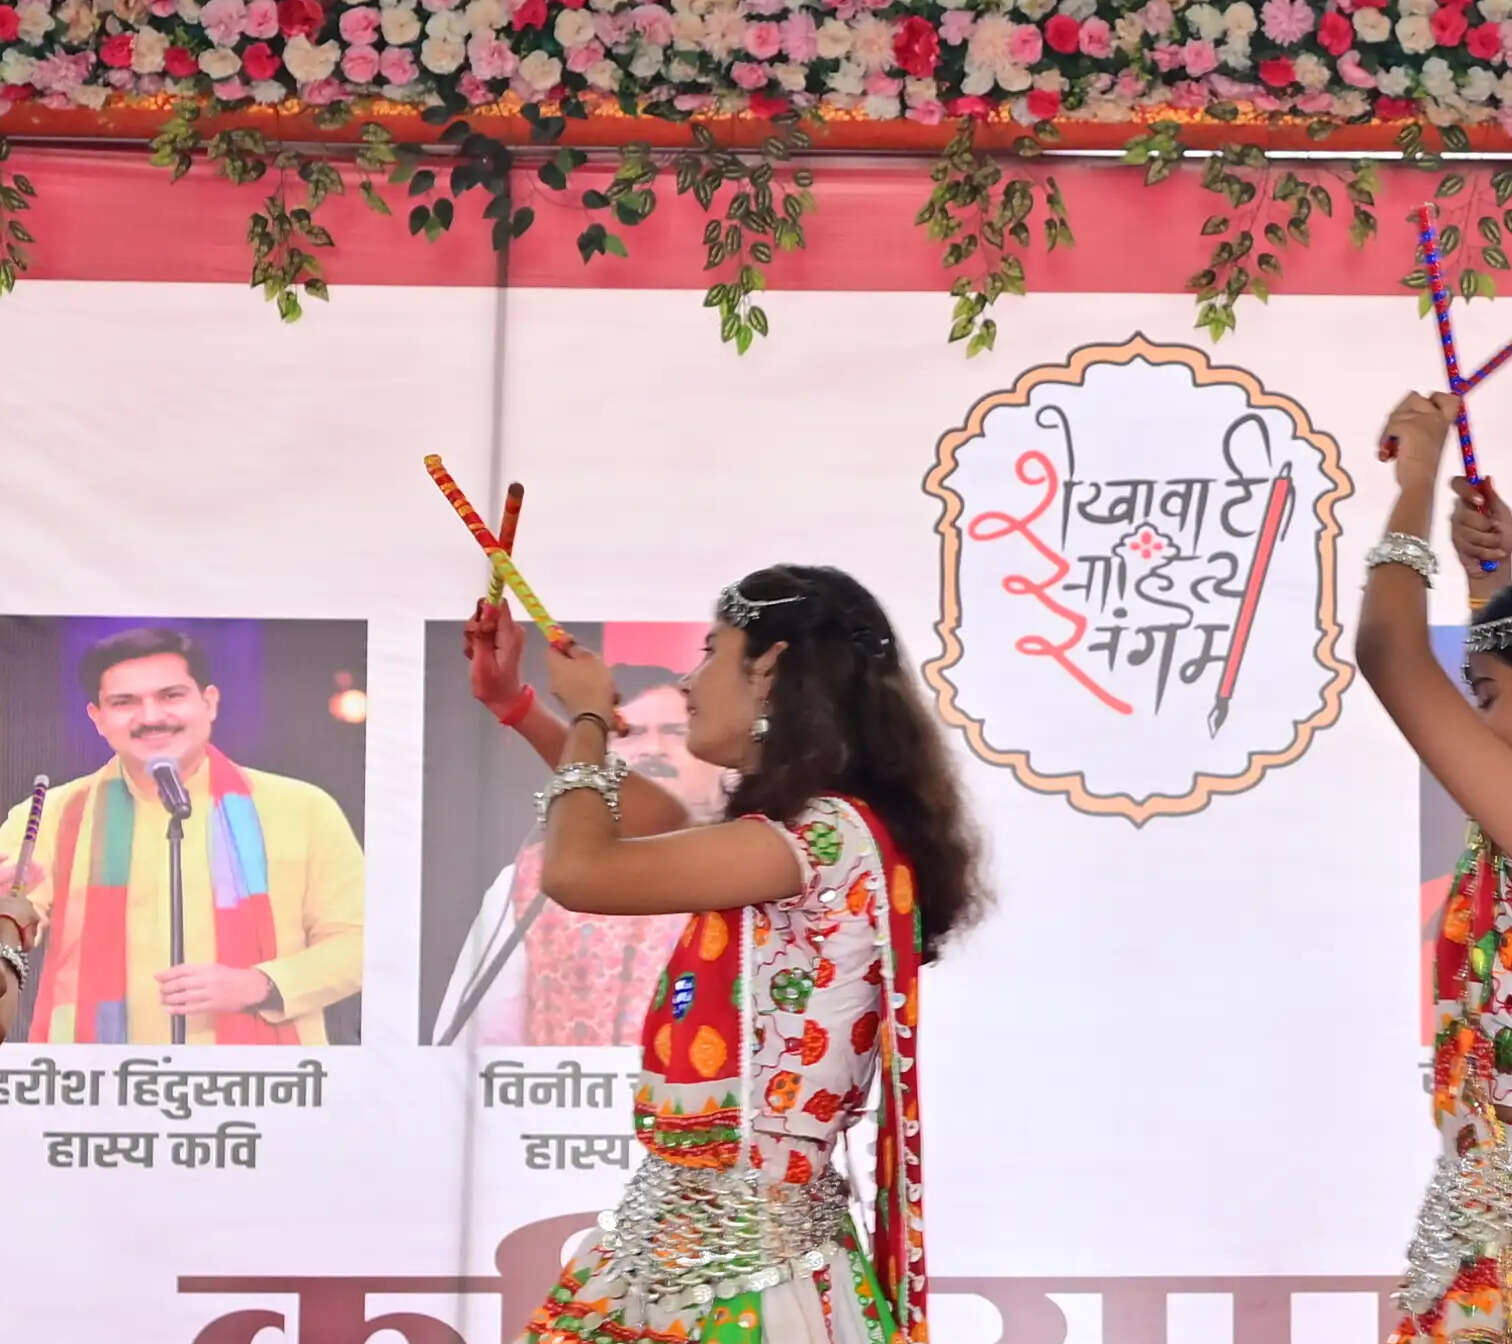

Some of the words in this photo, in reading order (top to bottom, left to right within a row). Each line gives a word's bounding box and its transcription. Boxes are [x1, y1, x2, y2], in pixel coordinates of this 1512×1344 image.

[113, 1055, 329, 1121] हिंदुस्तानी
[479, 1059, 619, 1109] विनीत
[42, 1130, 160, 1169] हास्य
[166, 1120, 262, 1170] कवि
[519, 1133, 636, 1170] हास्य
